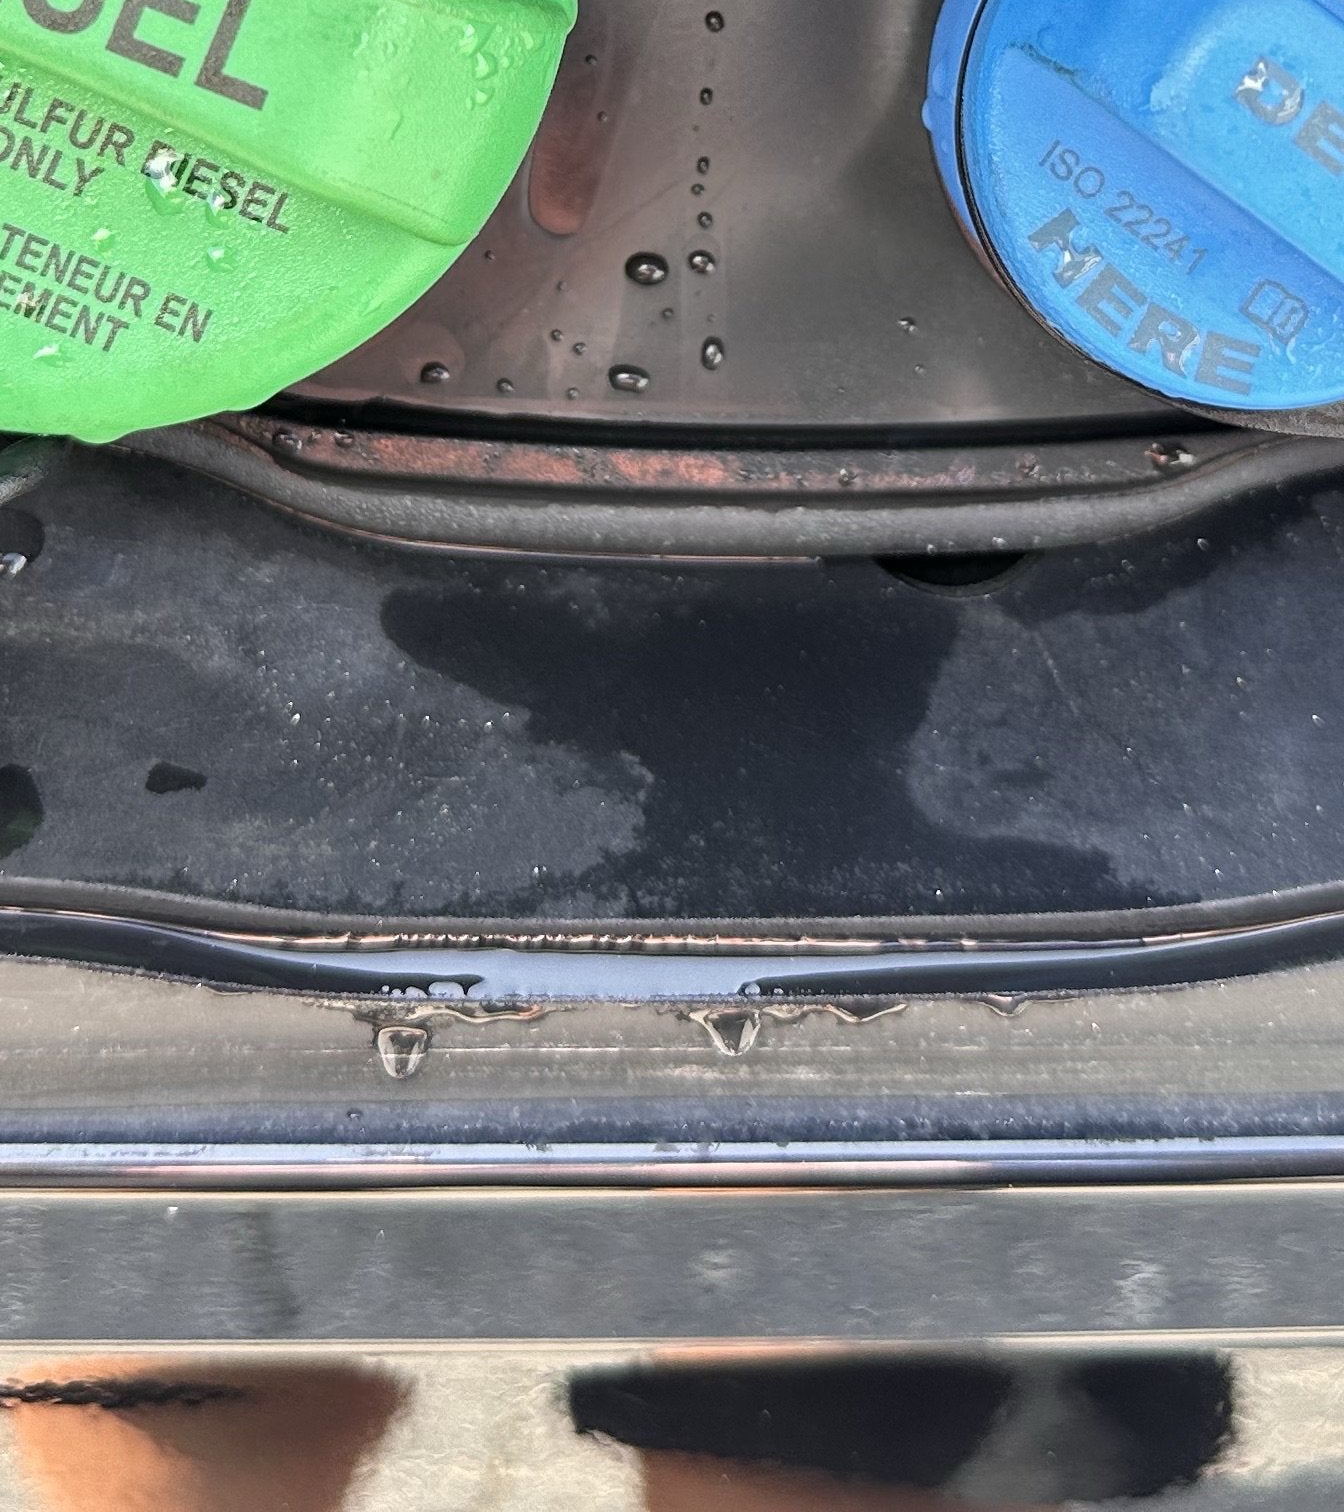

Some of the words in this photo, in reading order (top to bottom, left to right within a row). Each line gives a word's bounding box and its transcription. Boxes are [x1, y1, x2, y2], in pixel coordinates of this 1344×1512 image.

[1038, 140, 1106, 199] ISO
[1104, 190, 1208, 275] 22241
[154, 292, 212, 343] EN
[1027, 208, 1262, 396] HERE
